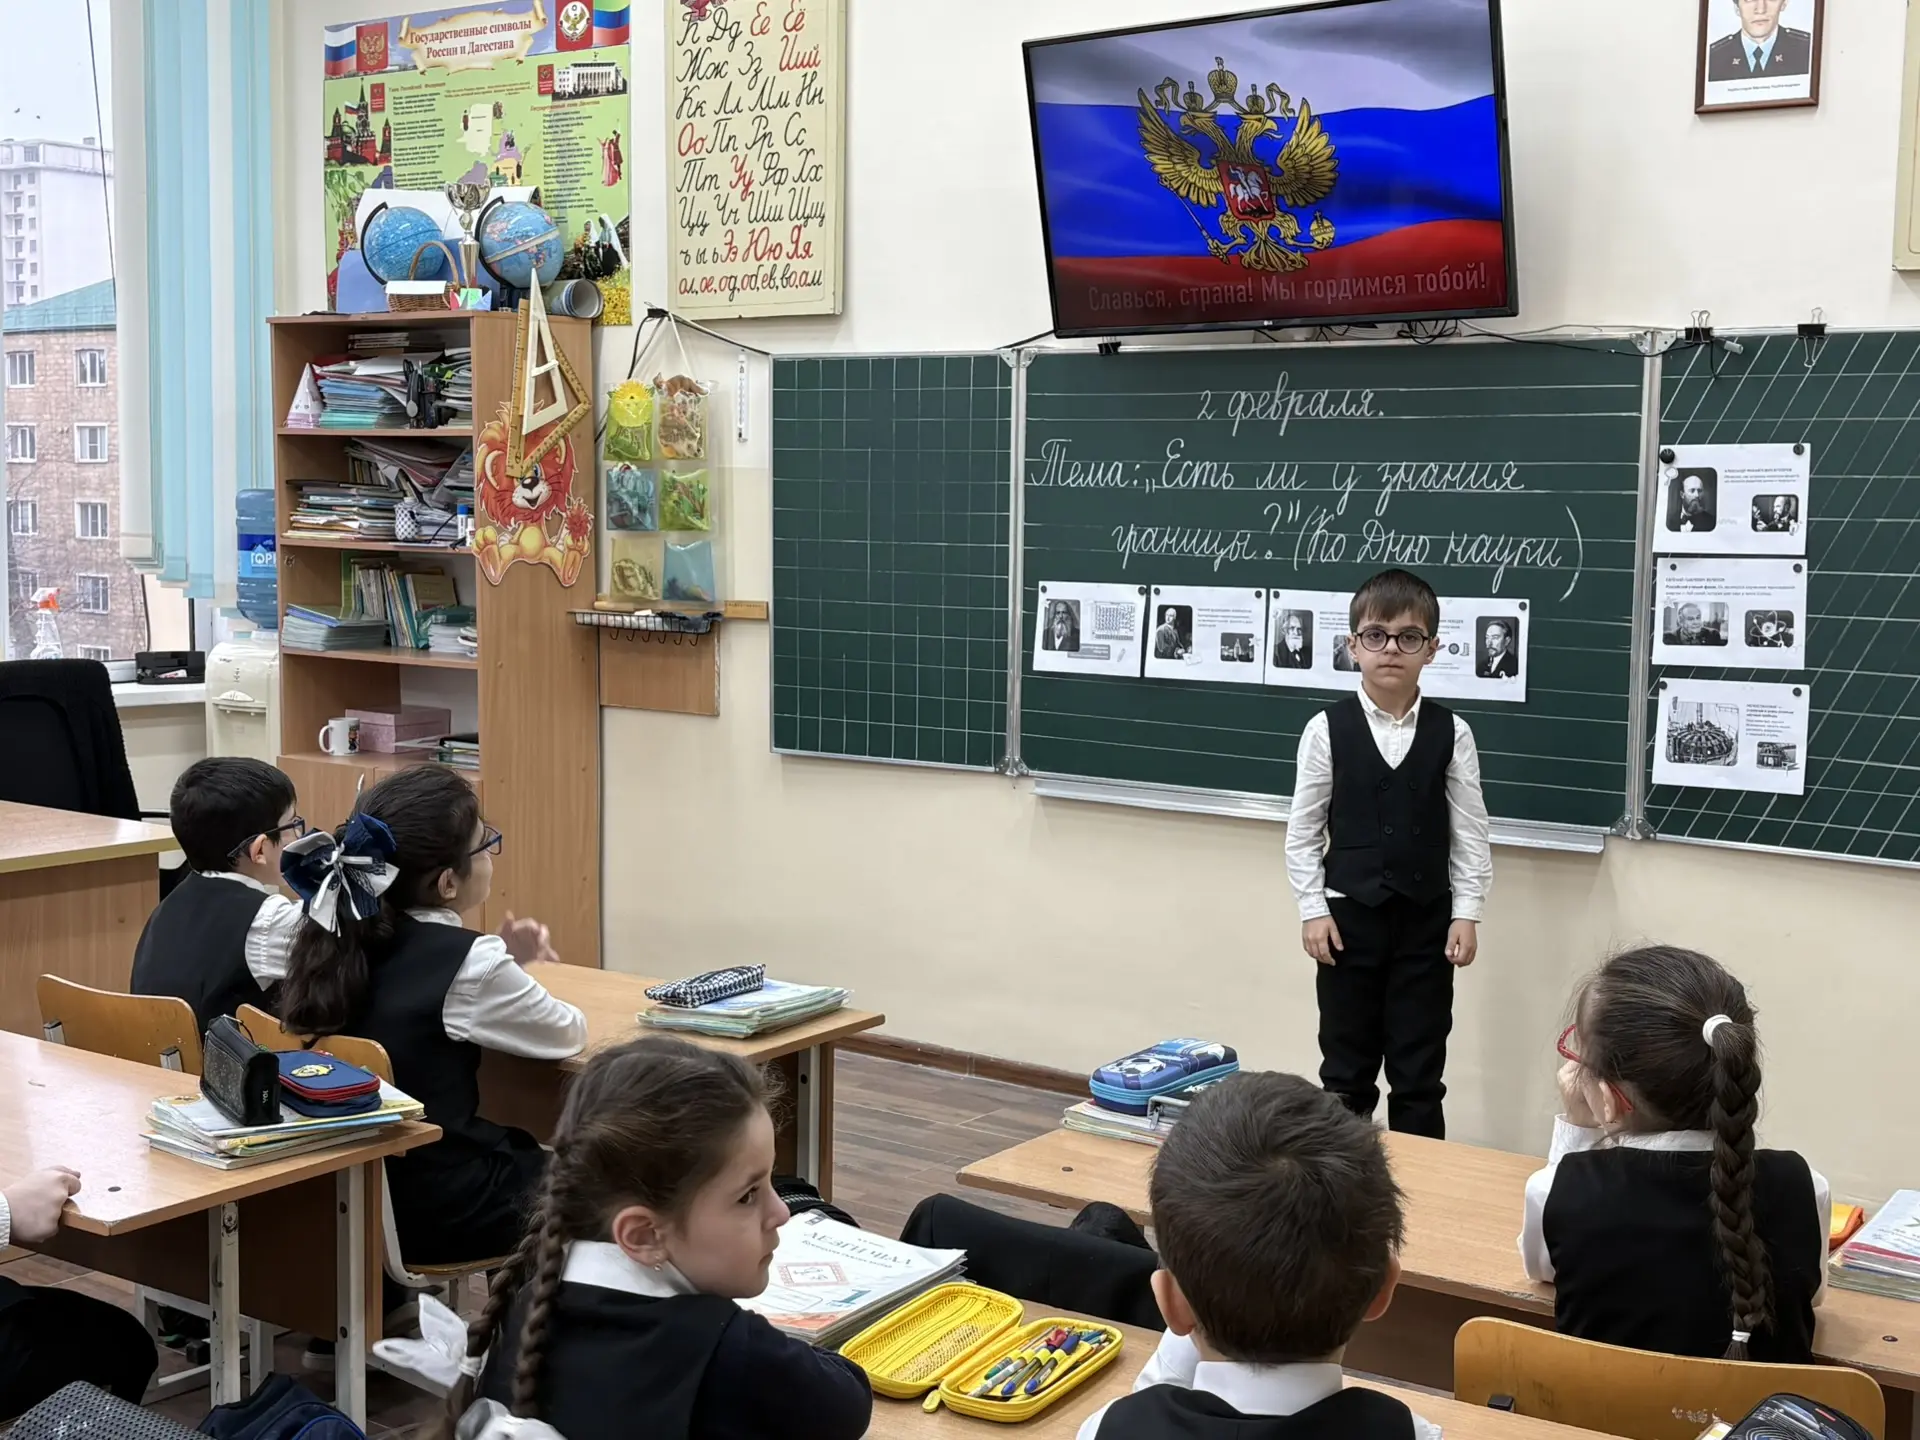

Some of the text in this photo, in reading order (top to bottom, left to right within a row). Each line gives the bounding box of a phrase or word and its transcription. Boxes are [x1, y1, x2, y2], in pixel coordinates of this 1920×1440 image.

[409, 19, 532, 46] Государственные символы
[426, 39, 515, 59] России и Дагестана
[706, 7, 743, 52] Дд
[750, 1, 771, 36] Ее
[676, 47, 729, 82] Жж
[738, 41, 763, 90] Зз
[676, 70, 825, 119] Кк Лл Мм Нн
[678, 112, 807, 162] Оо Пп Рр Сс
[676, 148, 823, 202] Тт Уу Фф Хх
[678, 186, 825, 237] Цц Чч Шш Щщ
[720, 228, 739, 263] Ээ
[742, 226, 783, 262] Юю
[786, 223, 814, 260] Яя
[1089, 262, 1486, 311] Славься, страна! Мы гордимся тобой!
[1198, 371, 1384, 437] 2 февраля.
[1030, 438, 1140, 488] Тема:
[1256, 460, 1308, 490] ли
[1332, 461, 1362, 516] у
[1376, 460, 1523, 517] знания
[1355, 519, 1430, 568] Дню
